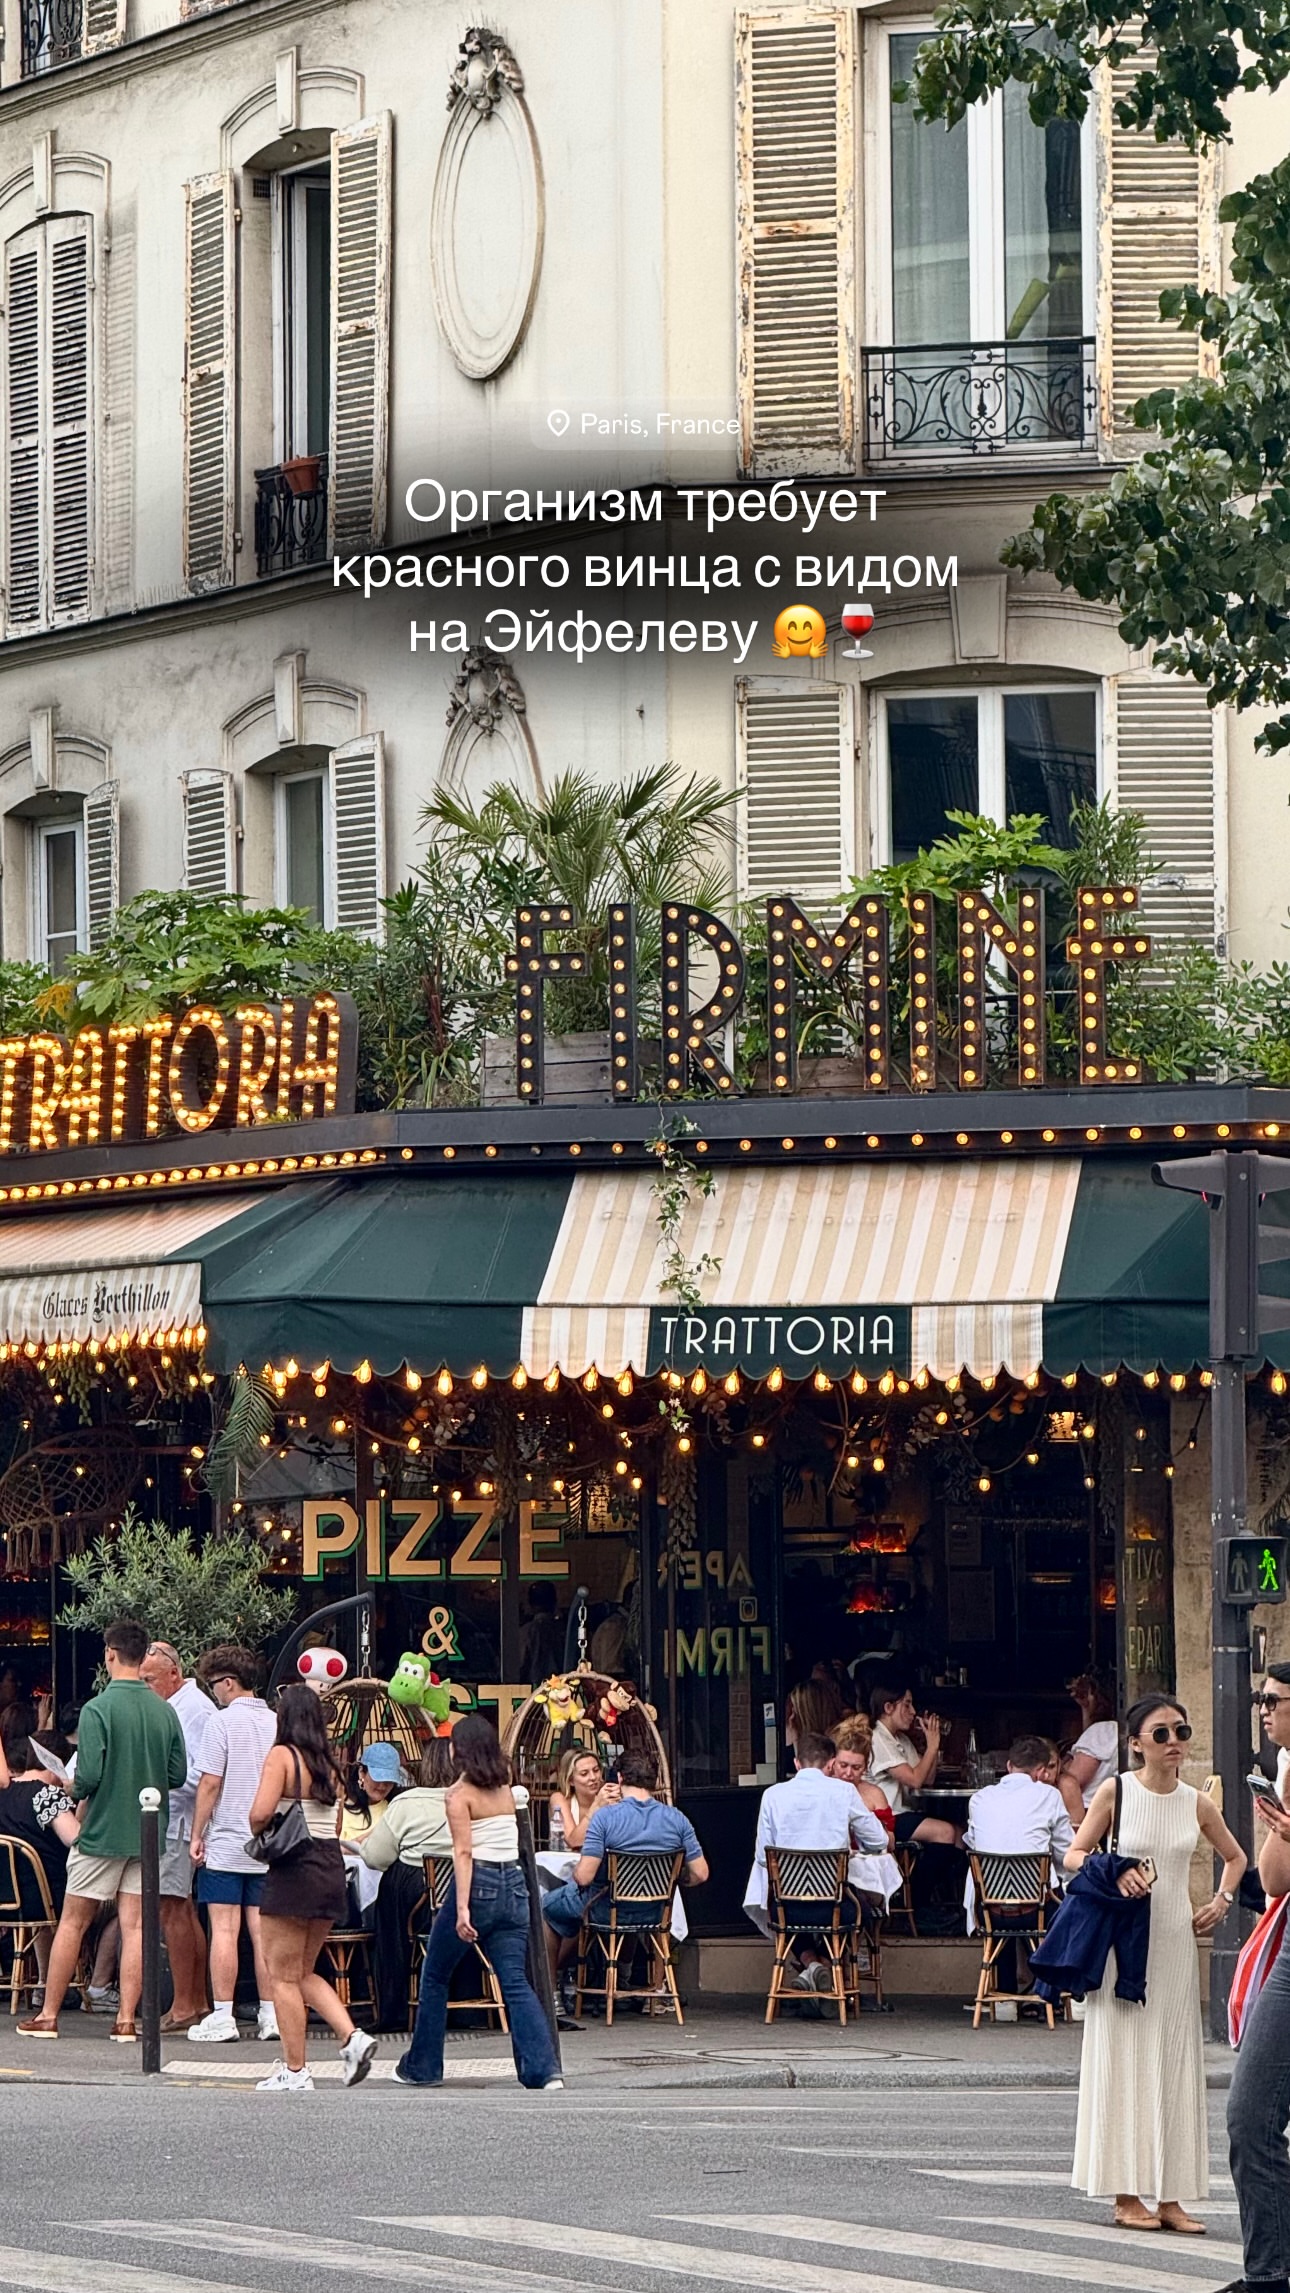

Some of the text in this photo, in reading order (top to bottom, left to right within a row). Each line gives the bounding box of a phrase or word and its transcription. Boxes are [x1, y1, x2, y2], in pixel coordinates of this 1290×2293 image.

[504, 886, 1152, 1102] FIRMINE
[0, 991, 346, 1158] TRATTORIA
[42, 1280, 171, 1324] Glaces Berthillon
[660, 1315, 894, 1356] TRATTORIA
[302, 1500, 570, 1582] PIZZE
[421, 1605, 465, 1661] &
